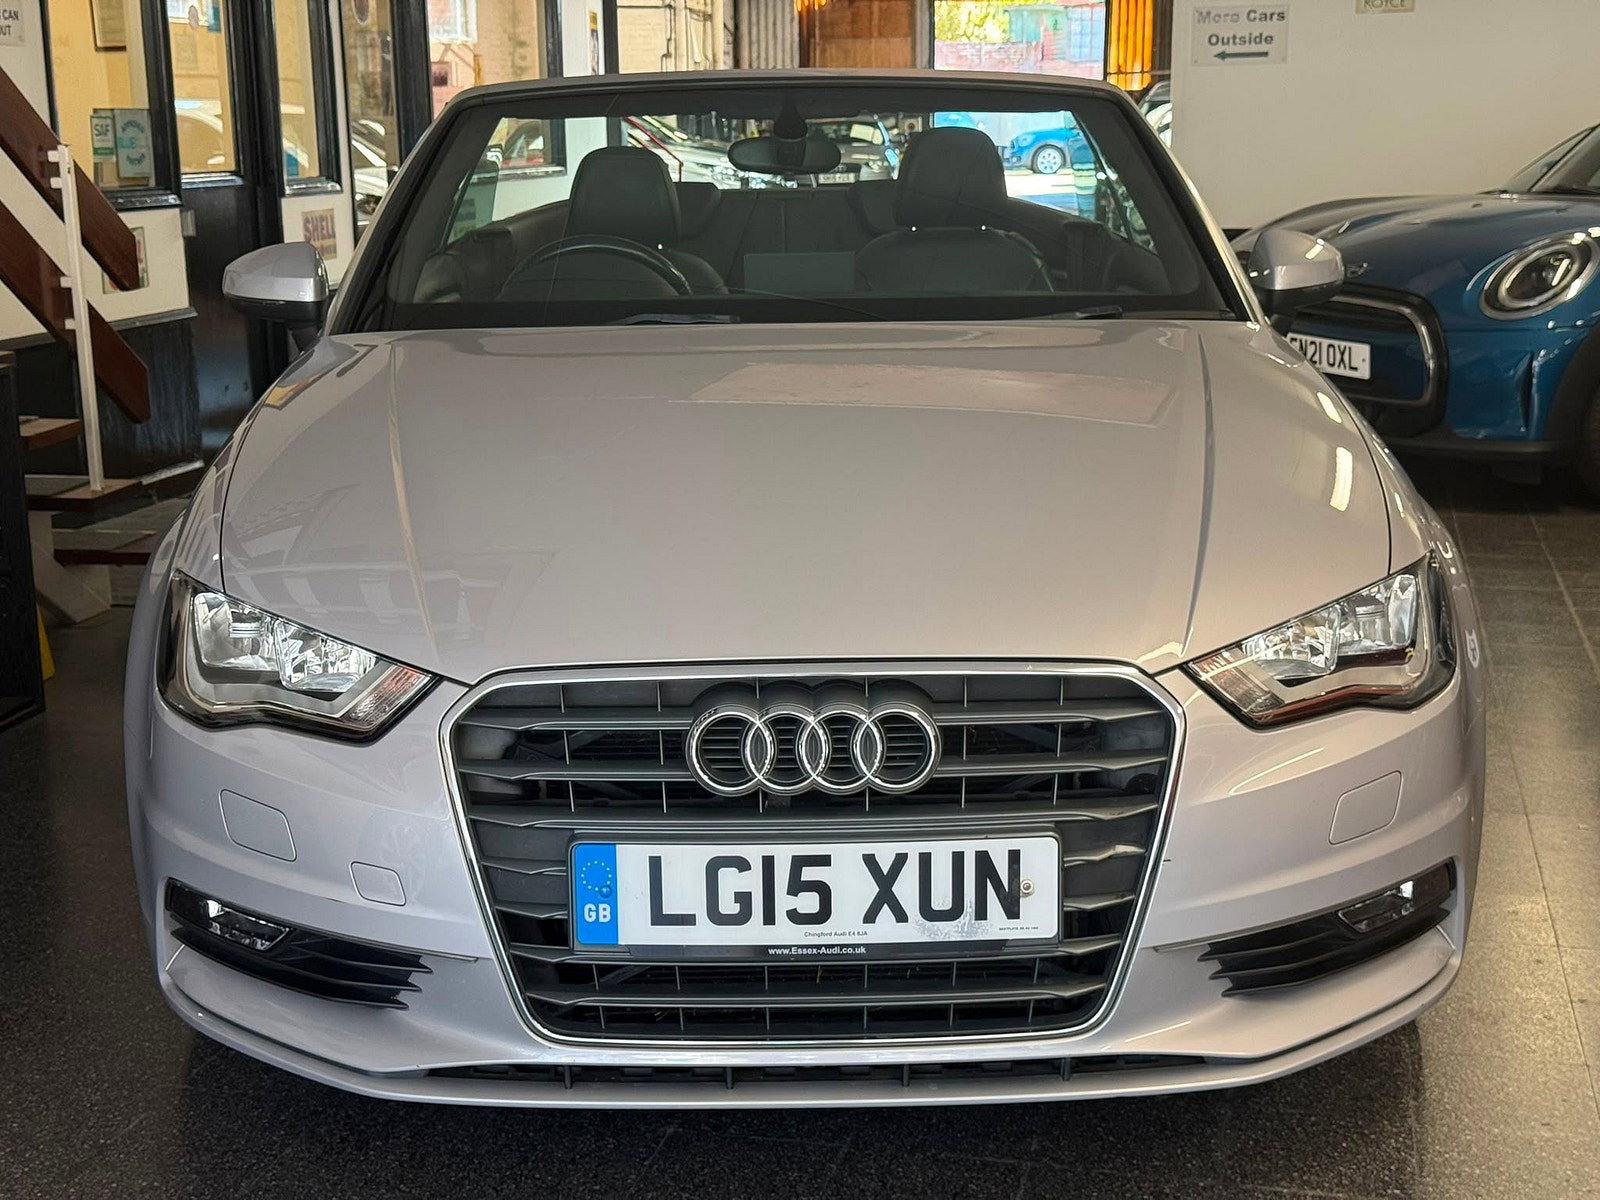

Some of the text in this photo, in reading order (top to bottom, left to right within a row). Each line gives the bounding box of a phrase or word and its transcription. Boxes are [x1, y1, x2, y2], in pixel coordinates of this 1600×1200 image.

[2, 9, 19, 21] CAN
[1196, 9, 1285, 23] More Cars
[1208, 32, 1274, 46] Outside
[303, 214, 336, 242] SHELL
[1327, 343, 1358, 372] OXL
[648, 849, 1021, 927] LG15 XUN
[584, 903, 611, 923] GB
[768, 946, 867, 955] www.Essex-Audi.co.uk
